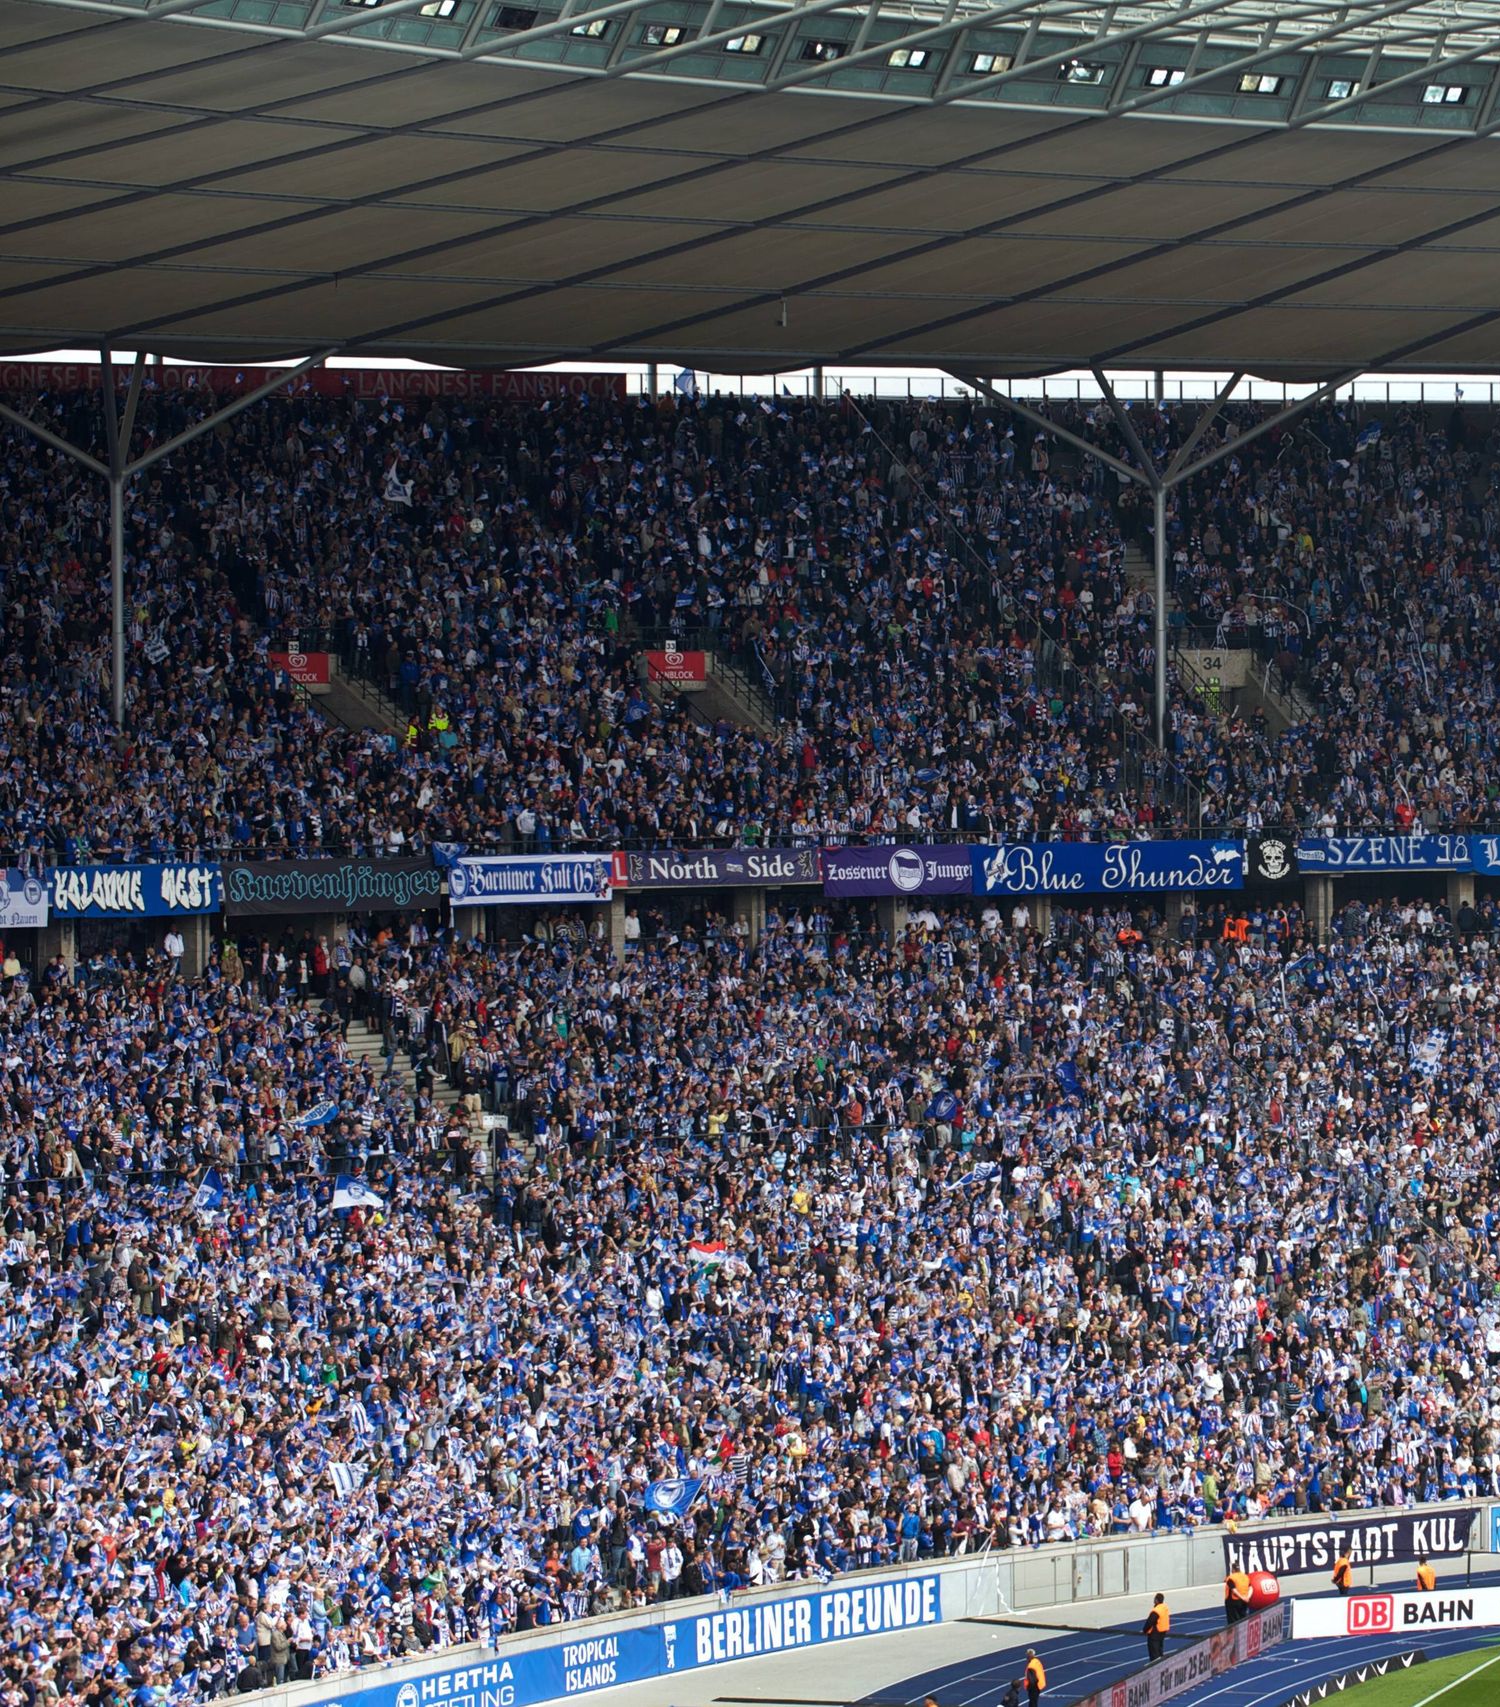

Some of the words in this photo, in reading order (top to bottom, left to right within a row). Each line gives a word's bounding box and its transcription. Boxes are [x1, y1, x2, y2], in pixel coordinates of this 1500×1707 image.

[358, 373, 482, 398] LANGNESE
[1203, 656, 1222, 670] 34
[1328, 836, 1426, 865] SZENE
[468, 862, 535, 894] Barnimer
[540, 861, 571, 892] Kult
[574, 862, 594, 893] 05
[649, 856, 719, 880] North
[747, 854, 795, 878] Side
[827, 864, 888, 881] Zossener
[1006, 846, 1085, 891] Blue
[1102, 844, 1234, 889] Thunder
[161, 867, 213, 909] WEST
[228, 865, 440, 907] Kurvenhänger
[1228, 1522, 1399, 1576] HAUPTSTADT
[1412, 1518, 1464, 1555] KUL
[696, 1599, 811, 1663] BERLINER
[820, 1578, 936, 1640] FREUNDE
[1262, 1613, 1283, 1643] BAHN
[1352, 1601, 1389, 1628] DB
[1403, 1599, 1473, 1625] BAHN
[562, 1637, 619, 1669] TROPICAL
[422, 1661, 514, 1700] HERTHA
[565, 1661, 616, 1692] ISLANDS
[1128, 1680, 1150, 1706] BAHN
[1160, 1665, 1172, 1694] Für
[1173, 1669, 1187, 1690] nur
[1188, 1657, 1197, 1680] 25
